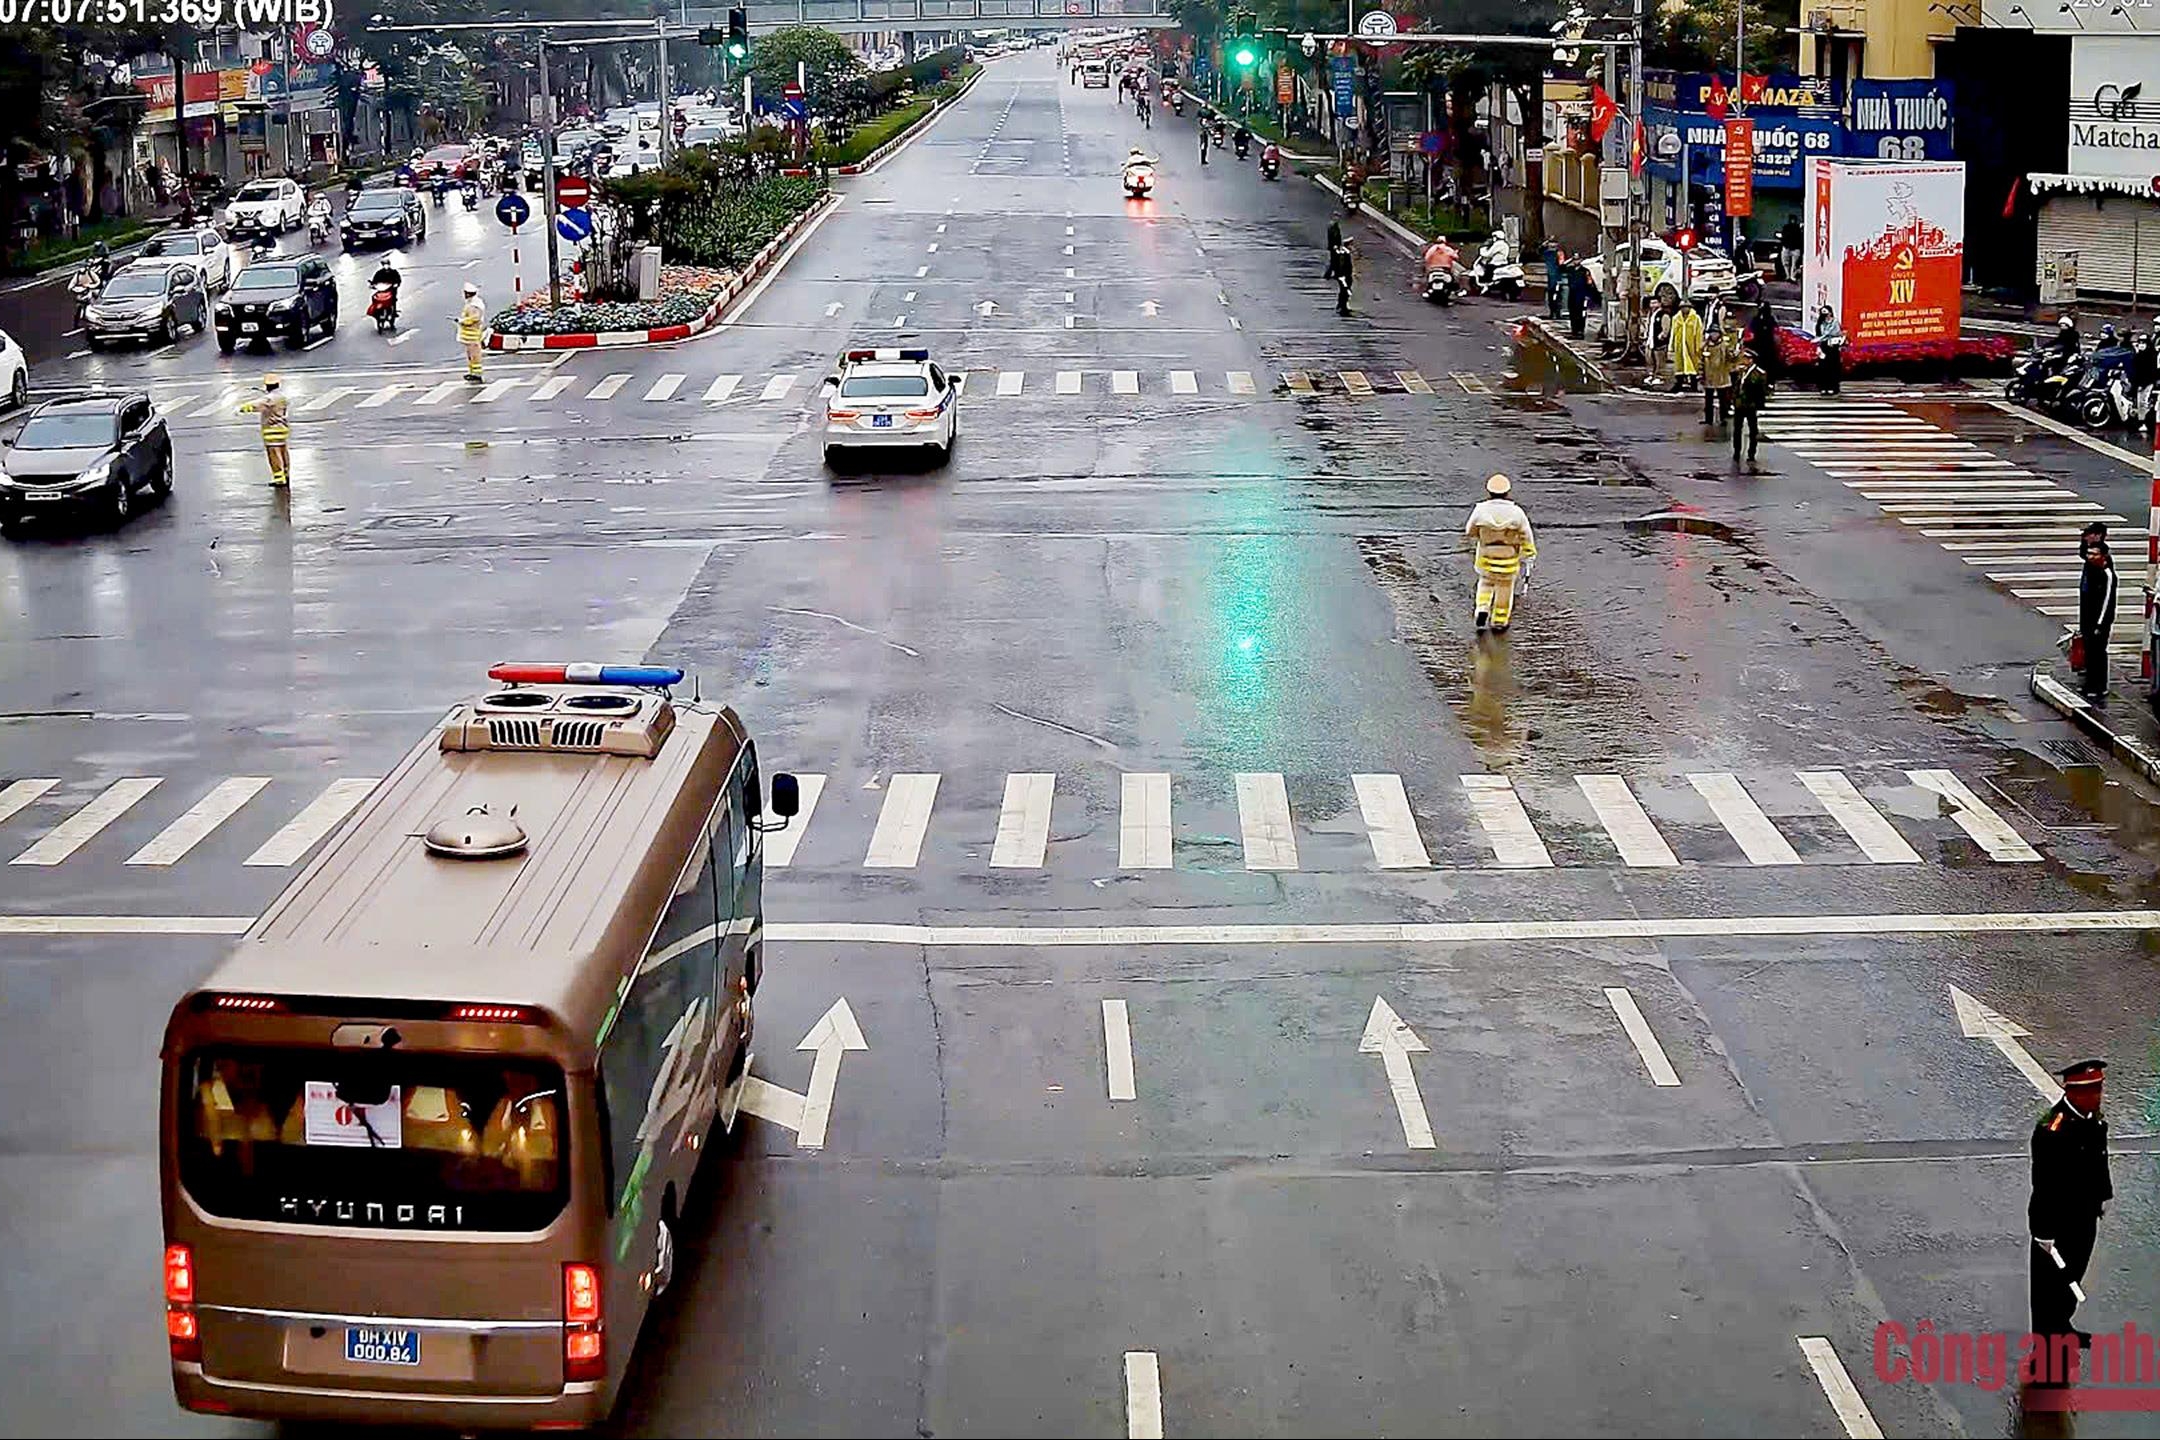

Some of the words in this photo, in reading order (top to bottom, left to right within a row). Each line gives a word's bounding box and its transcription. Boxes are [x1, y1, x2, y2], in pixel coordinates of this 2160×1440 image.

[1856, 91, 1891, 130] NHÀ
[1894, 87, 1947, 130] THUỐC
[1687, 125, 1726, 145] NHÀ
[1804, 132, 1830, 149] 68
[1878, 136, 1925, 161] 68
[2072, 123, 2160, 150] Matcha
[1889, 279, 1916, 304] XIV
[280, 1197, 462, 1225] HYUNDAI
